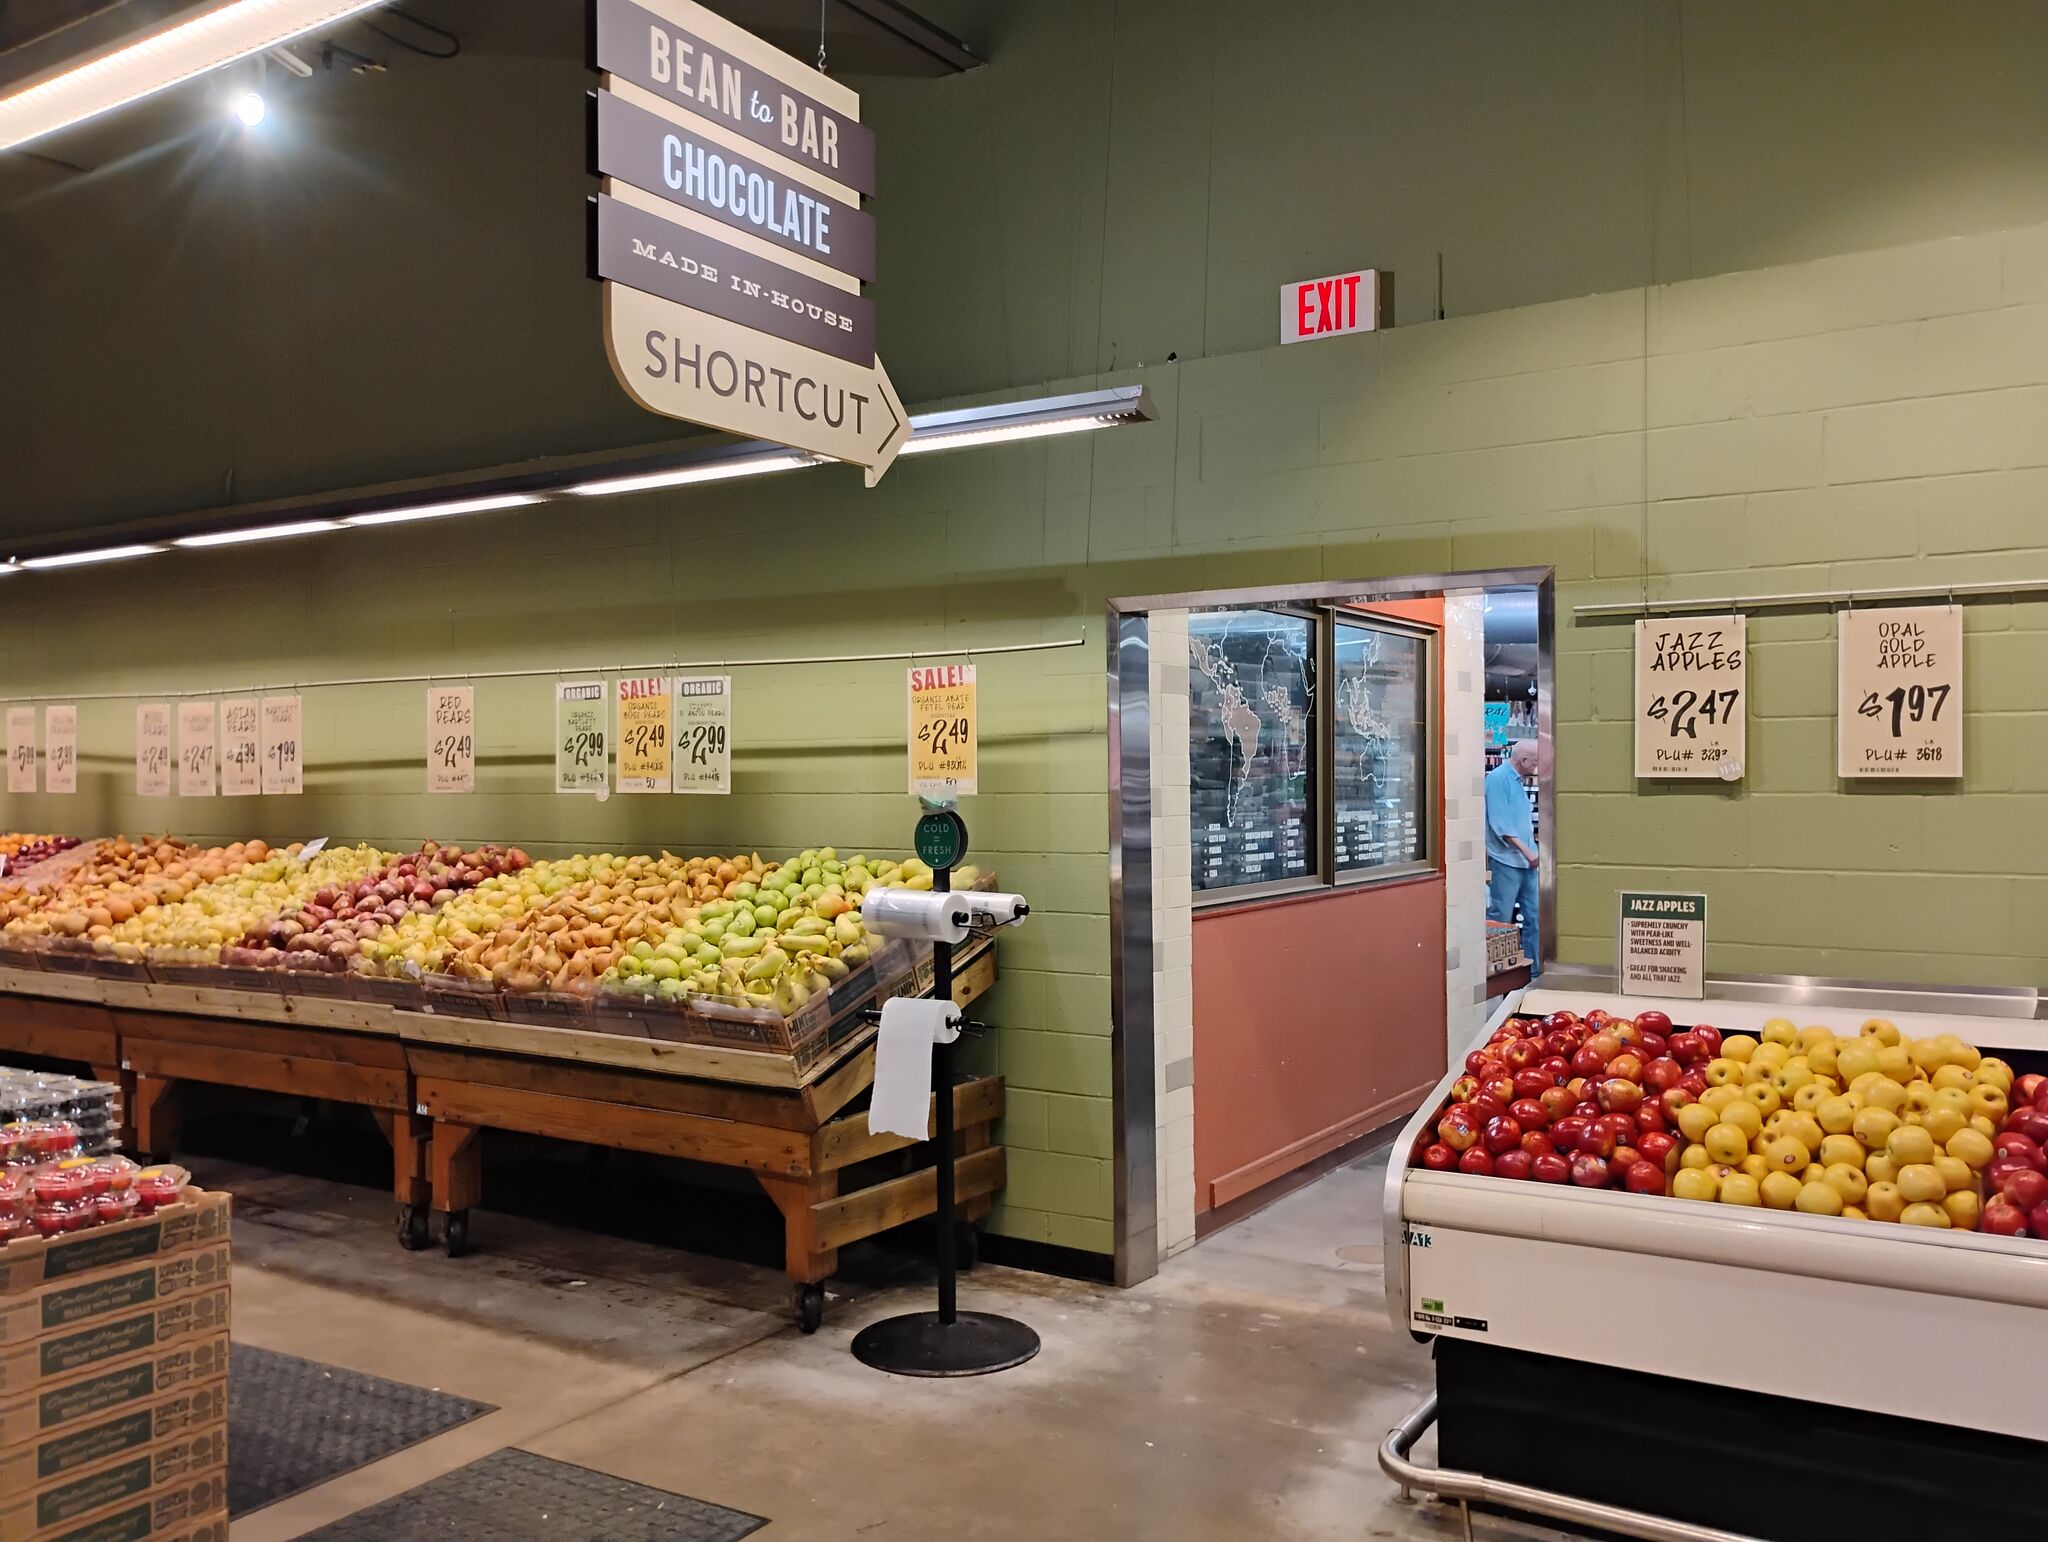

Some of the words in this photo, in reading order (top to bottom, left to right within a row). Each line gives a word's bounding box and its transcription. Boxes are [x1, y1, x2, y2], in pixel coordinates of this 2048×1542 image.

[649, 24, 743, 121] BEAN
[750, 90, 774, 124] to
[781, 92, 839, 170] BAR
[662, 133, 831, 256] CHOCOLATE
[632, 238, 718, 284] MADE
[731, 275, 853, 333] IN-HOUSE
[1298, 275, 1361, 336] EXIT
[644, 329, 870, 435] SHORTCUT
[1878, 622, 1925, 638] OPAL
[1655, 631, 1723, 651] JAZZ
[1879, 638, 1925, 654] GOLD
[1650, 650, 1742, 671] APPLES
[1877, 653, 1936, 668] APPLE
[911, 665, 964, 692] SALE!
[565, 686, 600, 699] ORGANIC
[620, 678, 661, 701] SALE!
[683, 681, 722, 696] ORGANIC
[440, 696, 461, 709] RED
[912, 695, 942, 704] ORGANIC
[945, 694, 969, 702] ABATE
[920, 703, 943, 712] FETEL
[947, 702, 966, 710] PEAR
[436, 709, 471, 724] PEARS
[1916, 747, 1943, 761] 3618
[923, 824, 949, 833] COLD
[922, 846, 952, 855] FRESH
[1630, 899, 1655, 911] JAZZ
[1656, 900, 1696, 913] APPLES
[1630, 921, 1661, 929] SUPREMELY
[1662, 922, 1688, 930] CRUNCHY
[1646, 930, 1674, 938] PEAR-LIKE
[1630, 938, 1662, 947] SWEETNESS
[1630, 947, 1658, 955] BALANCED
[1630, 964, 1647, 972] GREAT
[1659, 966, 1687, 974] SNACKING
